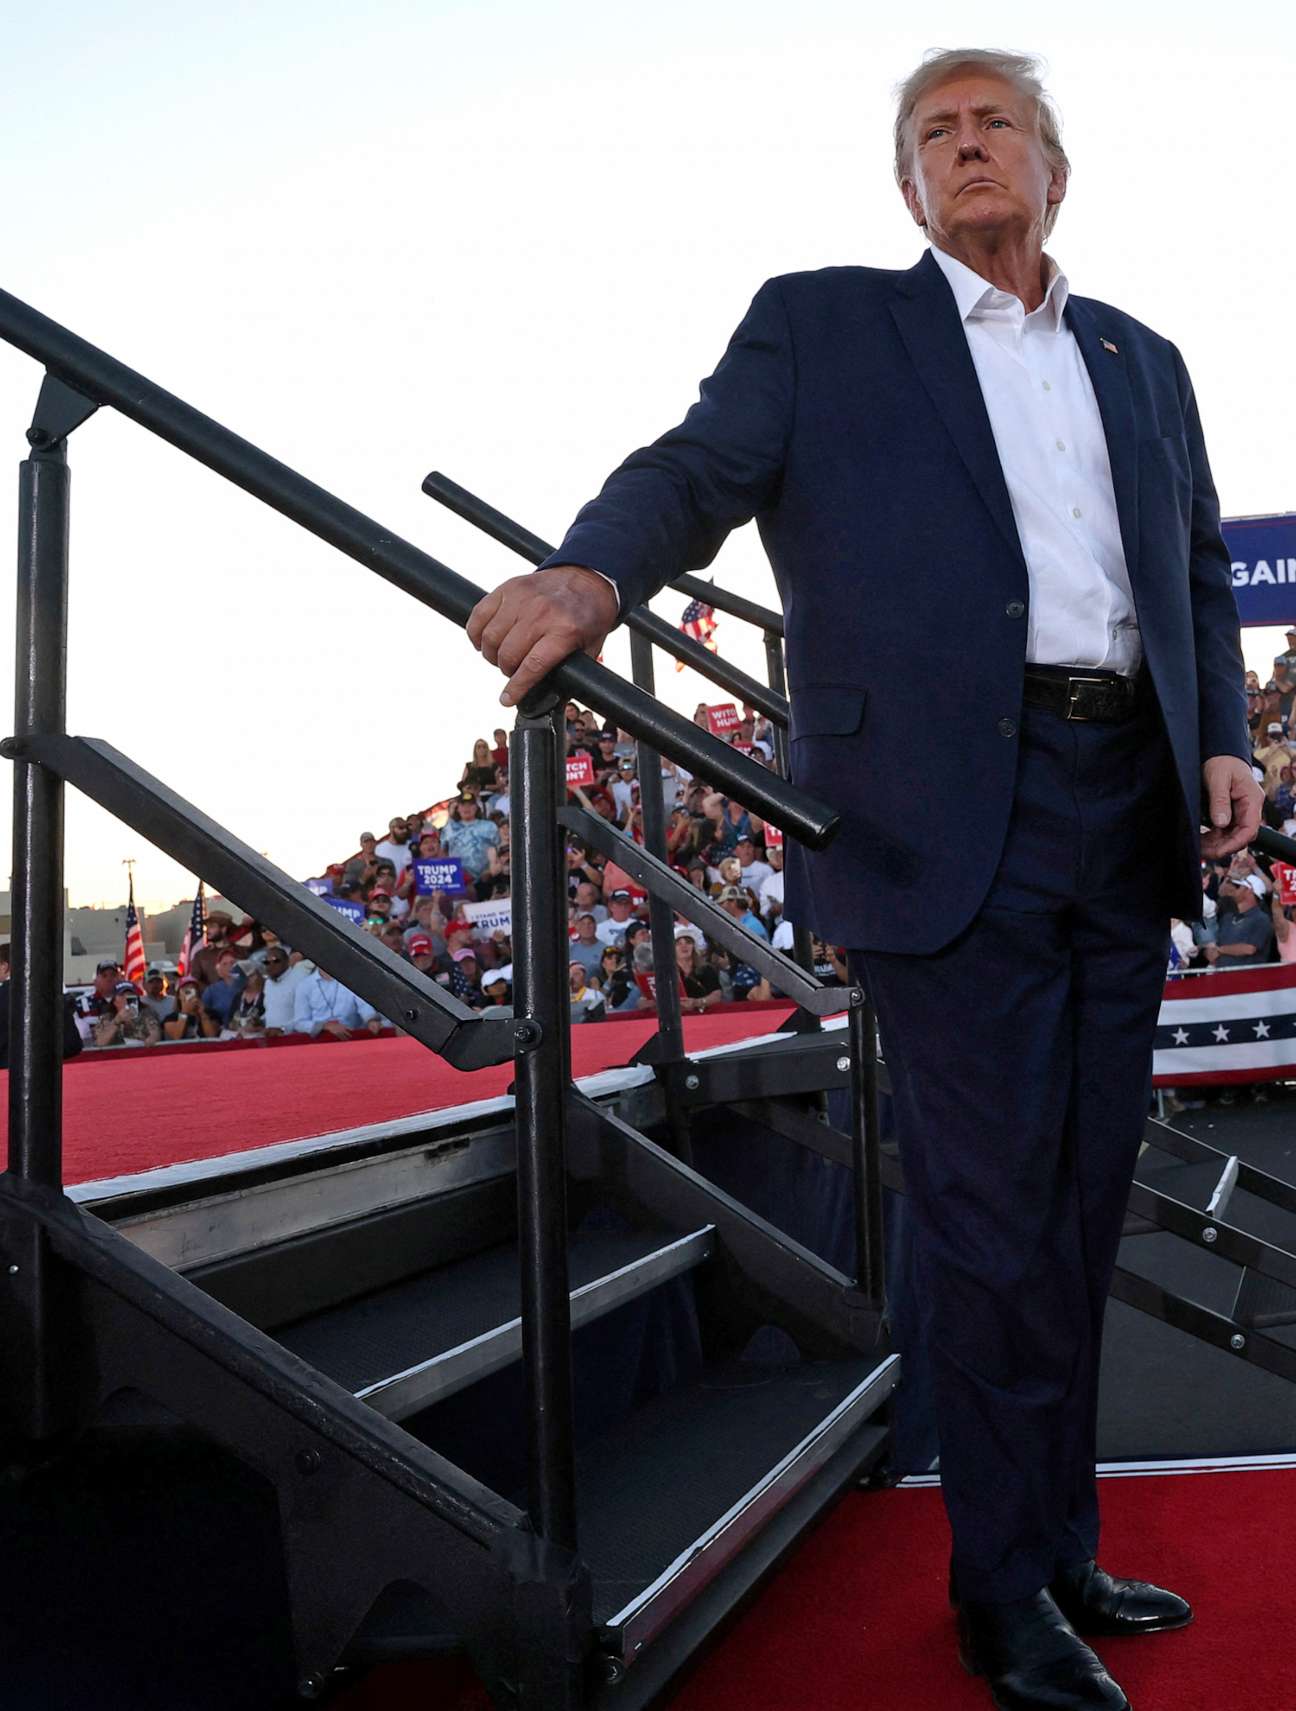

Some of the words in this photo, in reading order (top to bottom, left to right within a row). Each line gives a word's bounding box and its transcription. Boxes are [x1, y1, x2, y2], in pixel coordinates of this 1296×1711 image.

[566, 762, 588, 771] TCH
[417, 865, 457, 875] TRUMP
[424, 875, 453, 884] 2024
[476, 916, 511, 929] RUM
